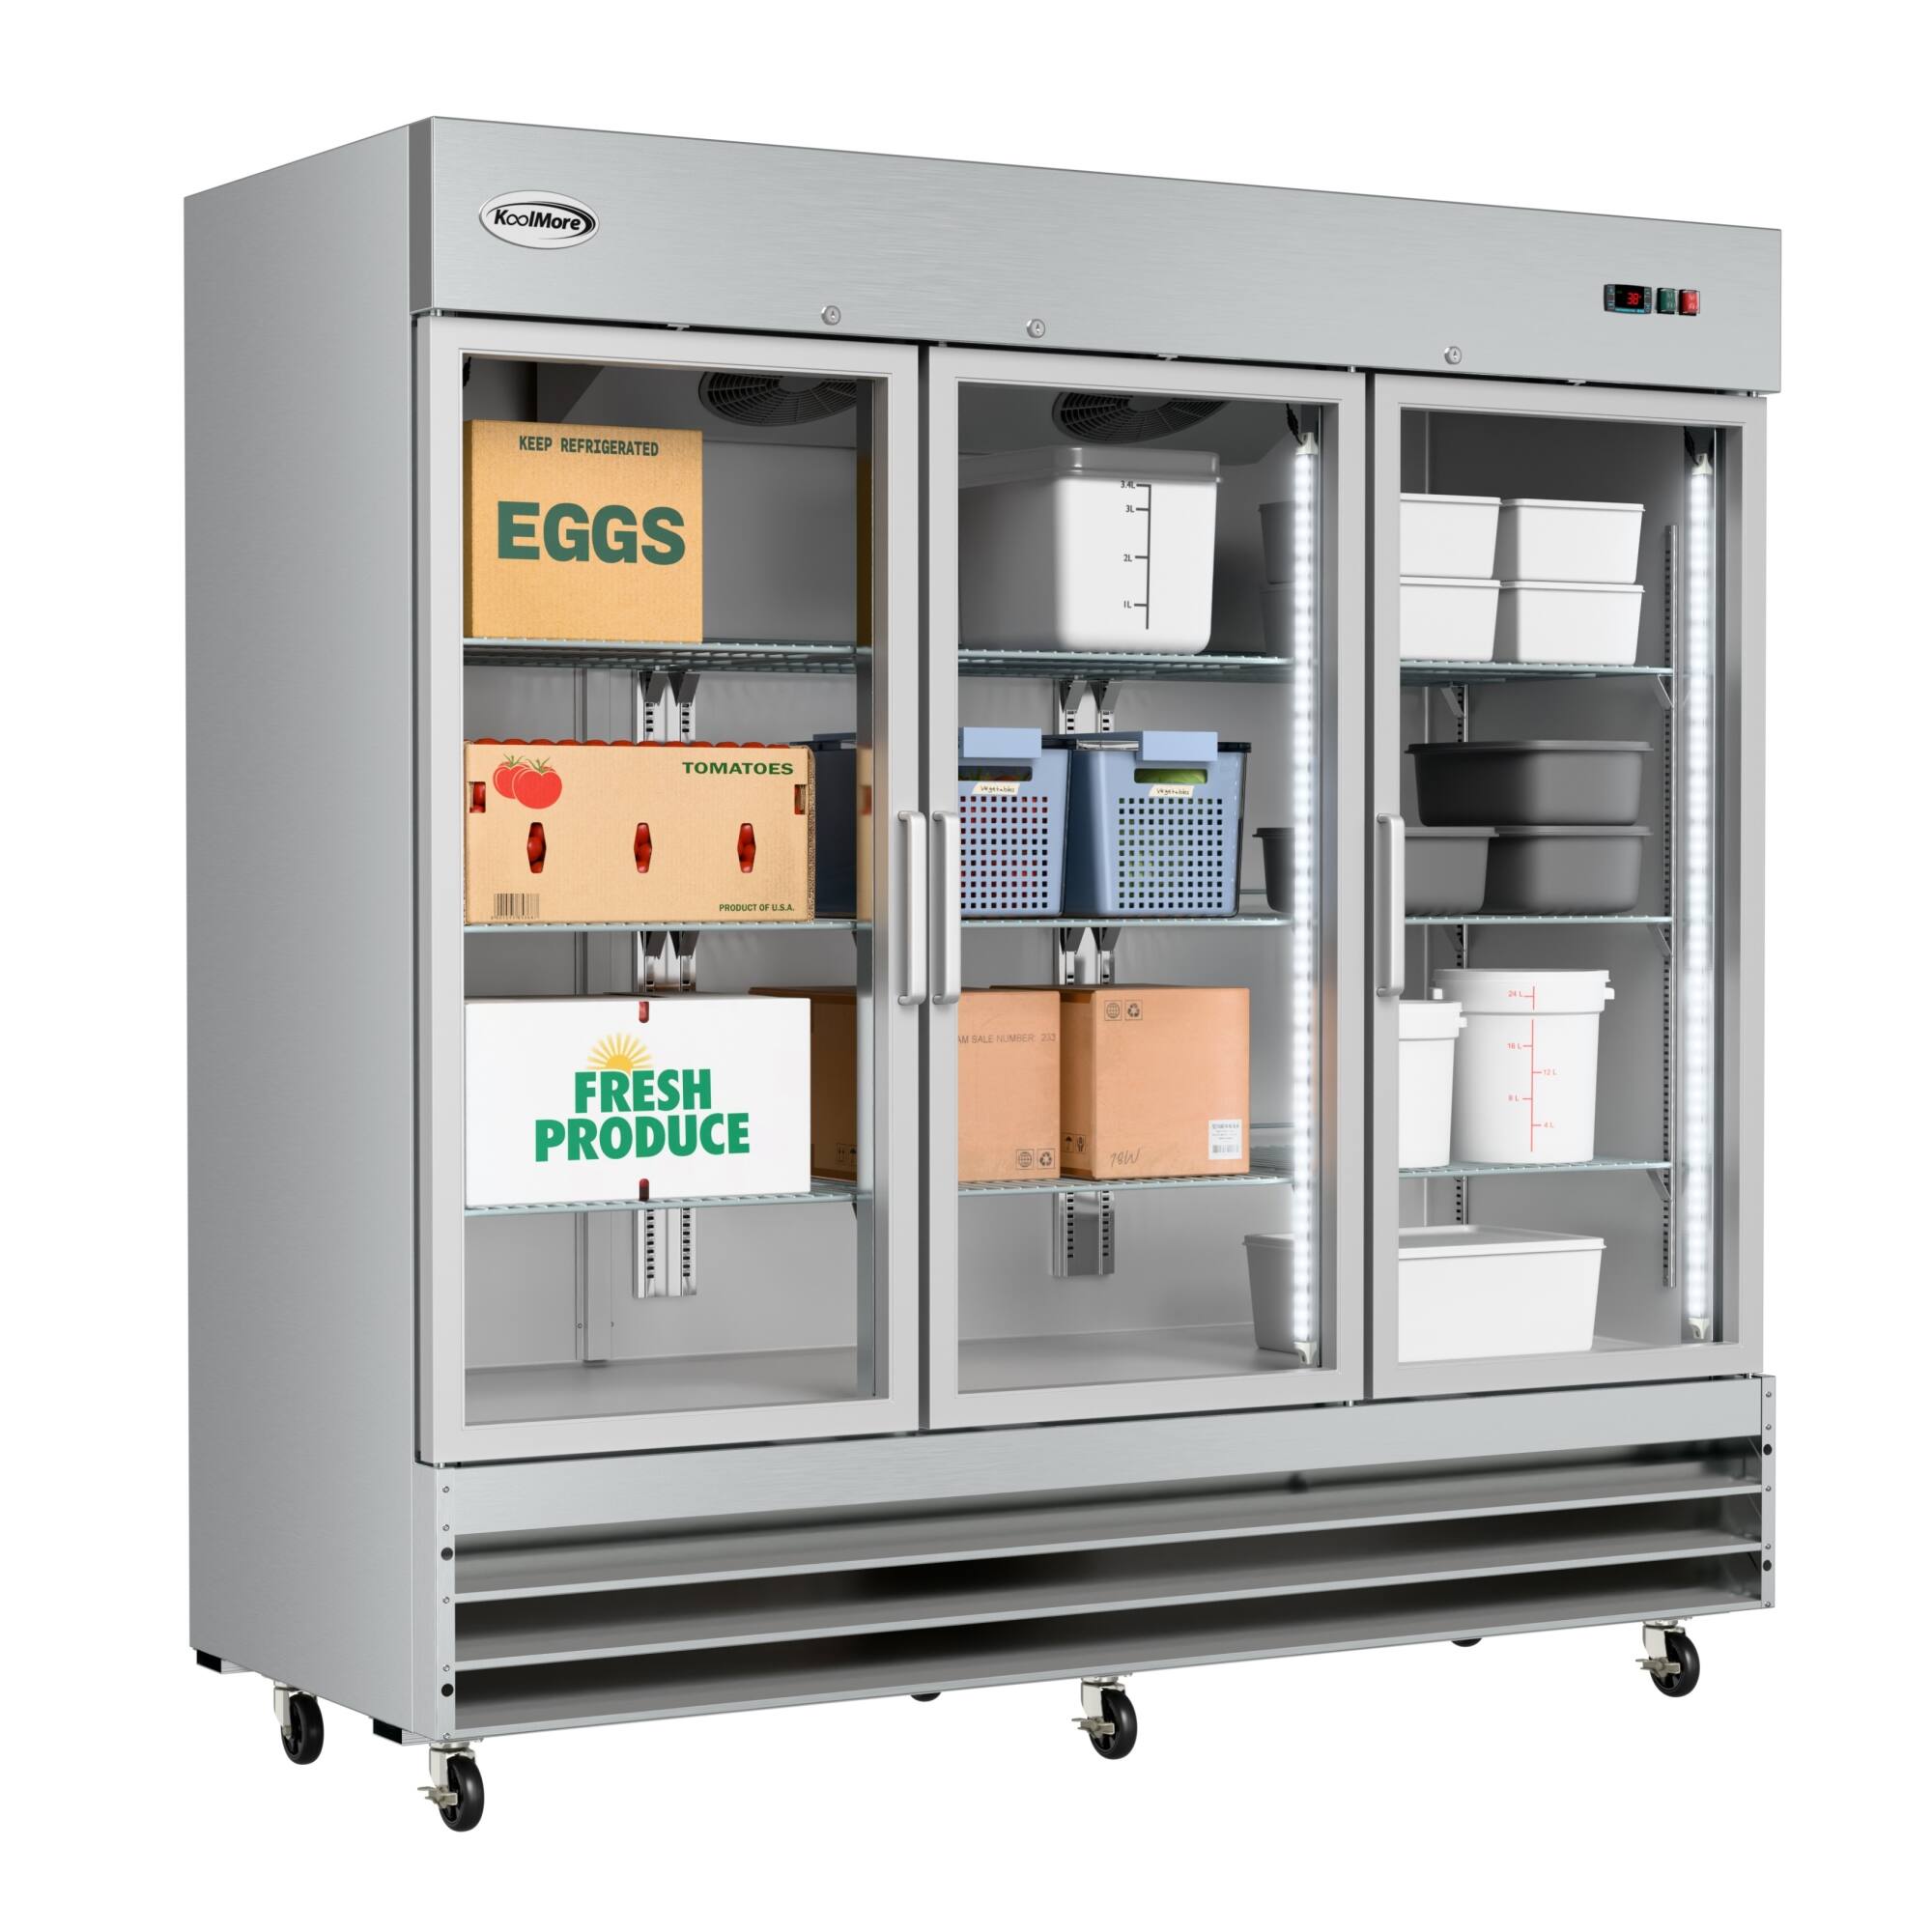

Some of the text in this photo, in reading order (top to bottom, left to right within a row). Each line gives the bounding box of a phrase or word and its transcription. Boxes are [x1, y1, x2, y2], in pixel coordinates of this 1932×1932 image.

[494, 209, 582, 231] KoolMore
[519, 435, 659, 456] KEEP REFRIGERATED
[1121, 480, 1135, 489] 3.4L
[1125, 504, 1135, 513] 3L
[497, 500, 685, 566] EGGS
[1123, 554, 1132, 562] 2L
[682, 761, 794, 775] TOMATOES
[719, 903, 795, 912] PRODUCT OF U.S.A.
[972, 1035, 994, 1044] SALE
[575, 1068, 712, 1113] FRESH
[535, 1112, 750, 1162] PRODUCE
